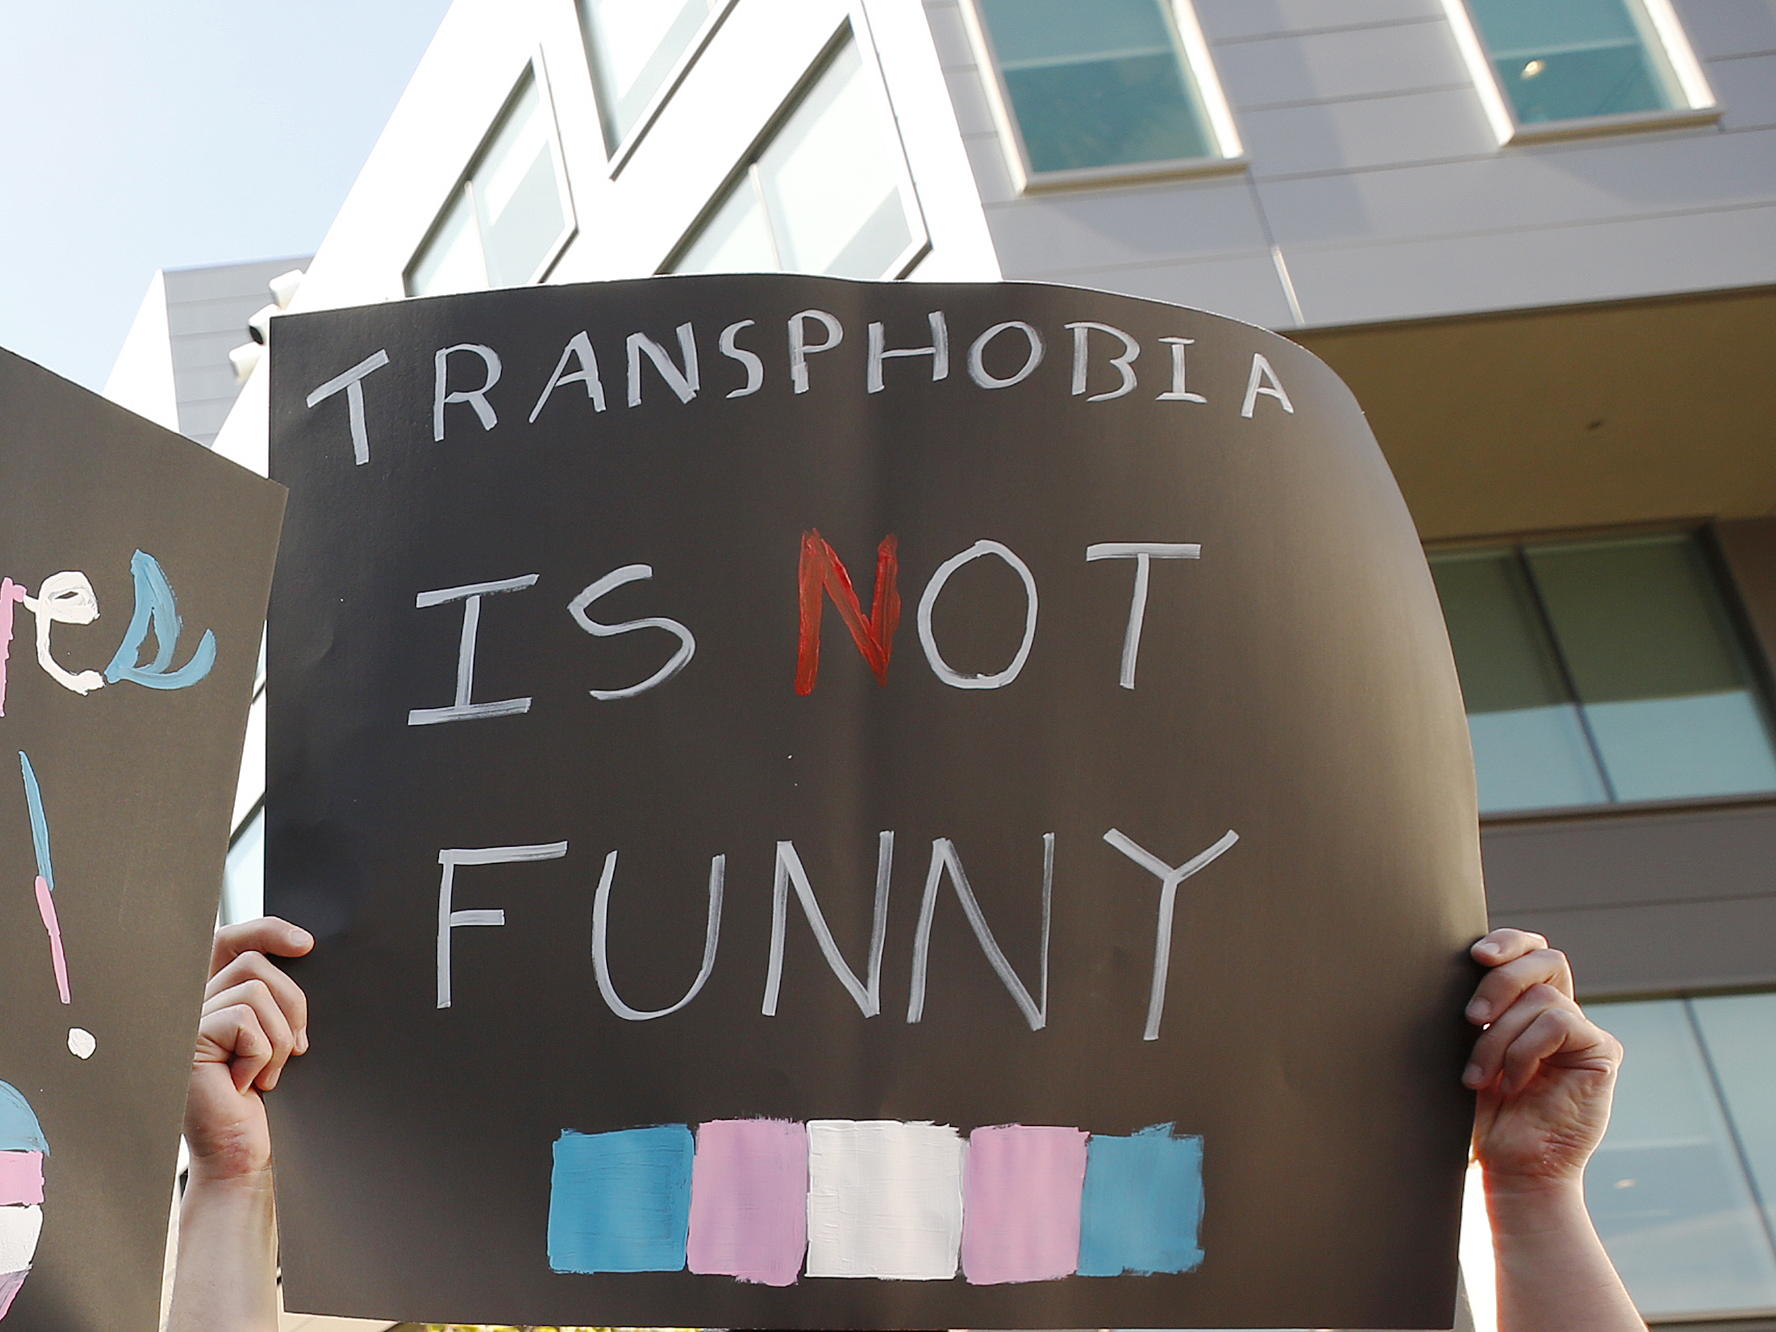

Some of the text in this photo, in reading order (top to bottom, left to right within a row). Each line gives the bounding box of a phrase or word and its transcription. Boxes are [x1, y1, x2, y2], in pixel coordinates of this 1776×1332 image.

[306, 309, 1295, 466] TRANSPHOBIA
[408, 528, 1201, 725] IS NOT
[437, 828, 1239, 1040] FUNNY
